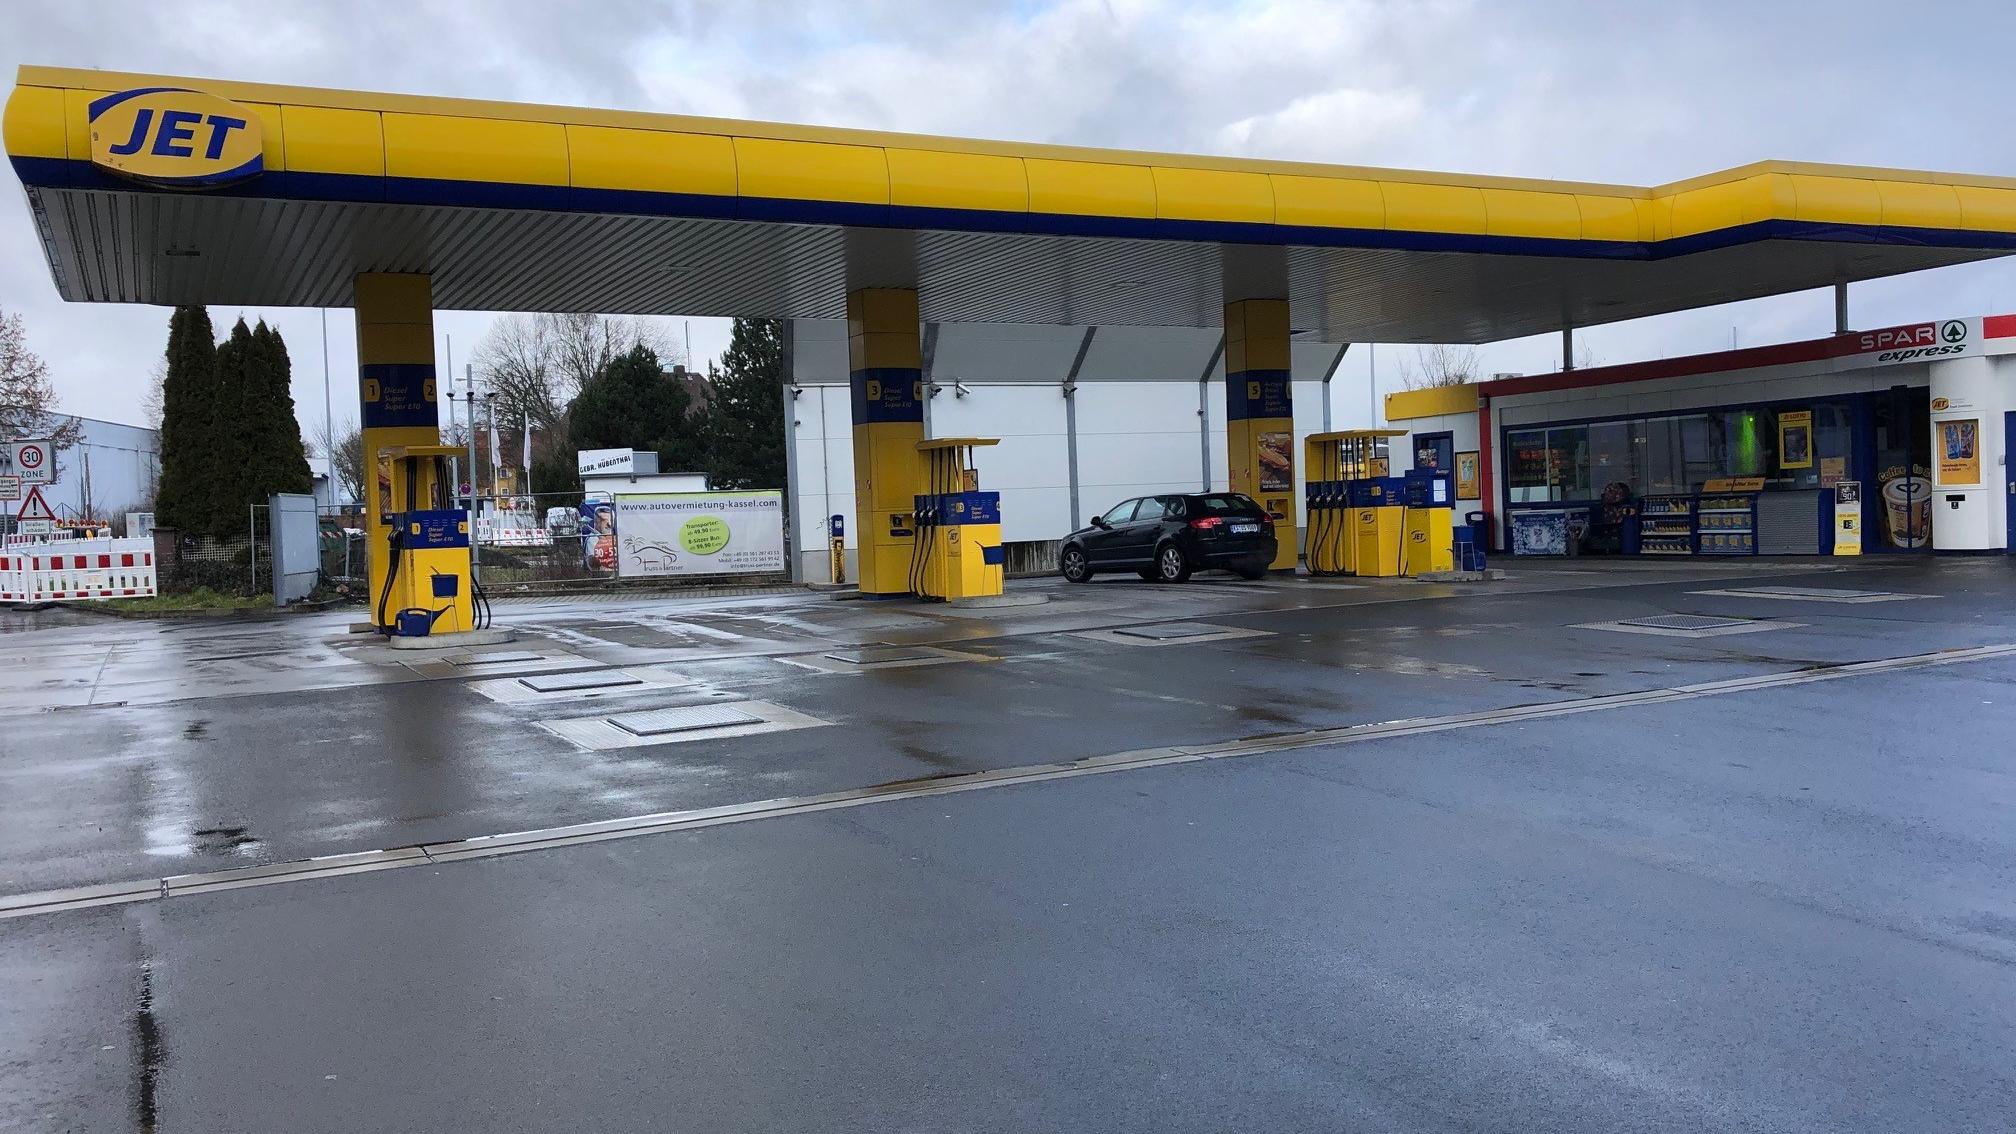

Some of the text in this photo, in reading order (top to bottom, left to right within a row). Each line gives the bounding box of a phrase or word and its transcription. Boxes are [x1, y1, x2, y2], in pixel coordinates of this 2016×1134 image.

[110, 108, 246, 160] JET
[1860, 326, 1935, 350] SPAR
[1878, 344, 1967, 362] express
[369, 384, 376, 396] 1
[384, 386, 408, 394] Diesel
[426, 384, 435, 396] 2
[872, 385, 878, 396] 3
[915, 385, 921, 396] 4
[1252, 385, 1258, 395] 5
[384, 402, 406, 411] Super
[1933, 400, 1947, 409] JET
[24, 451, 39, 462] 30
[579, 464, 596, 474] GEBR.
[620, 499, 778, 511] www.autovermietung-kassel.com
[594, 548, 603, 557] 30
